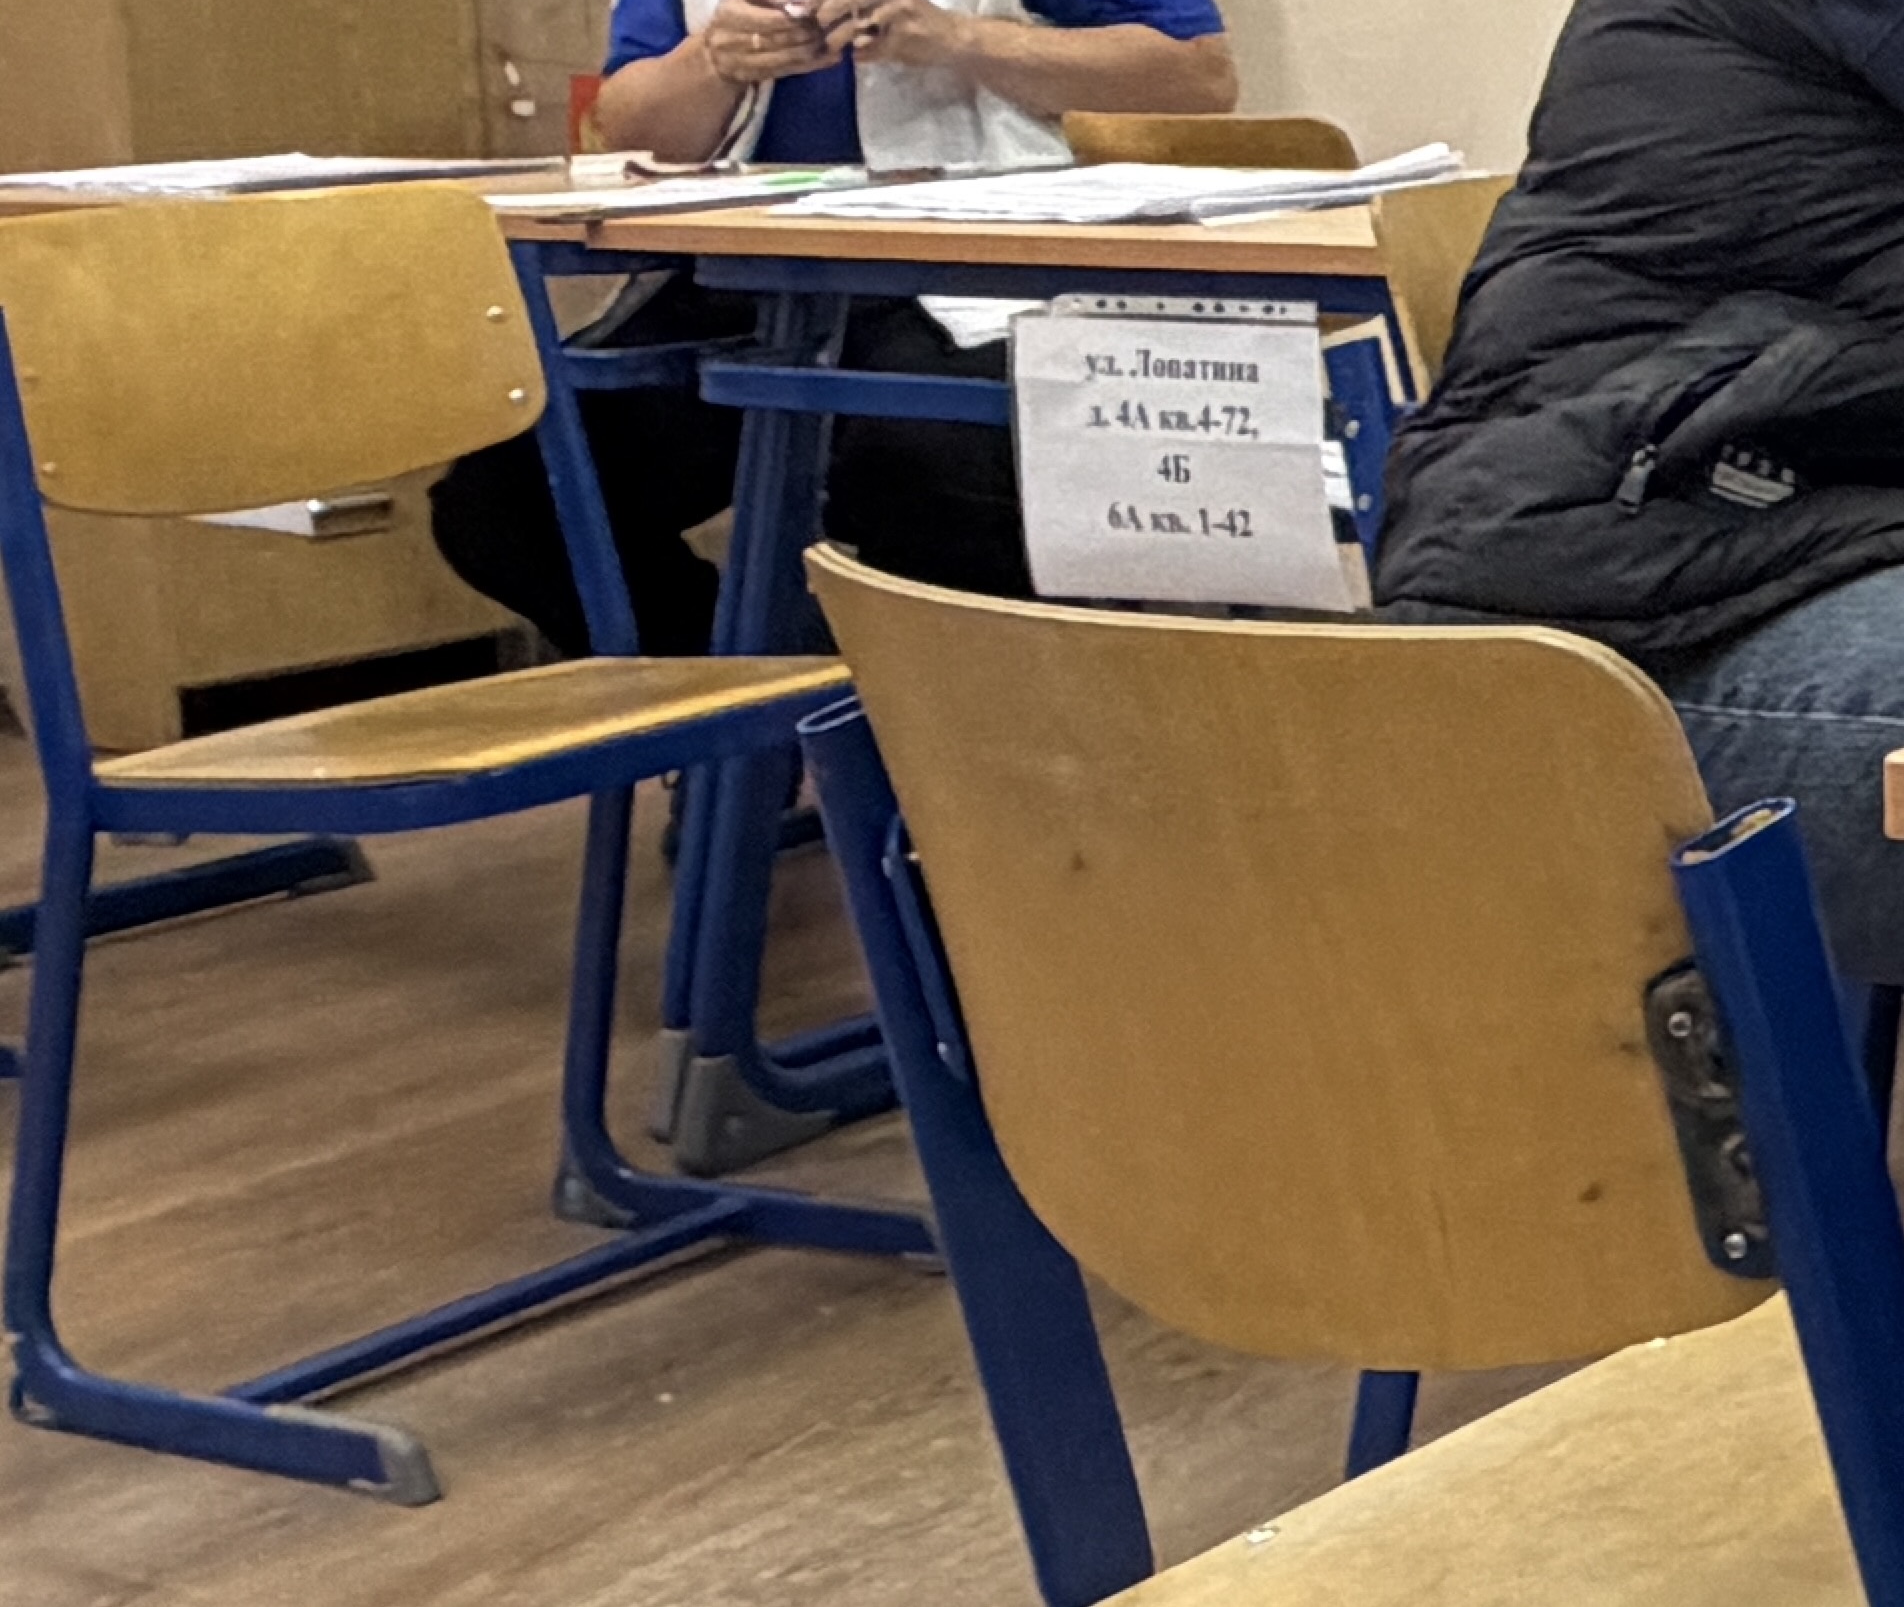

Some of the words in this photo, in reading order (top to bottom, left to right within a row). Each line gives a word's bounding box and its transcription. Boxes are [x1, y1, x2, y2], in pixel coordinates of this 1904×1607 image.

[1083, 352, 1123, 382] ул.
[1129, 349, 1260, 383] Лопатина
[1116, 400, 1150, 430] 4А
[1156, 453, 1190, 483] 4Б
[1107, 501, 1143, 532] 6А
[1199, 507, 1254, 538] 1-42
